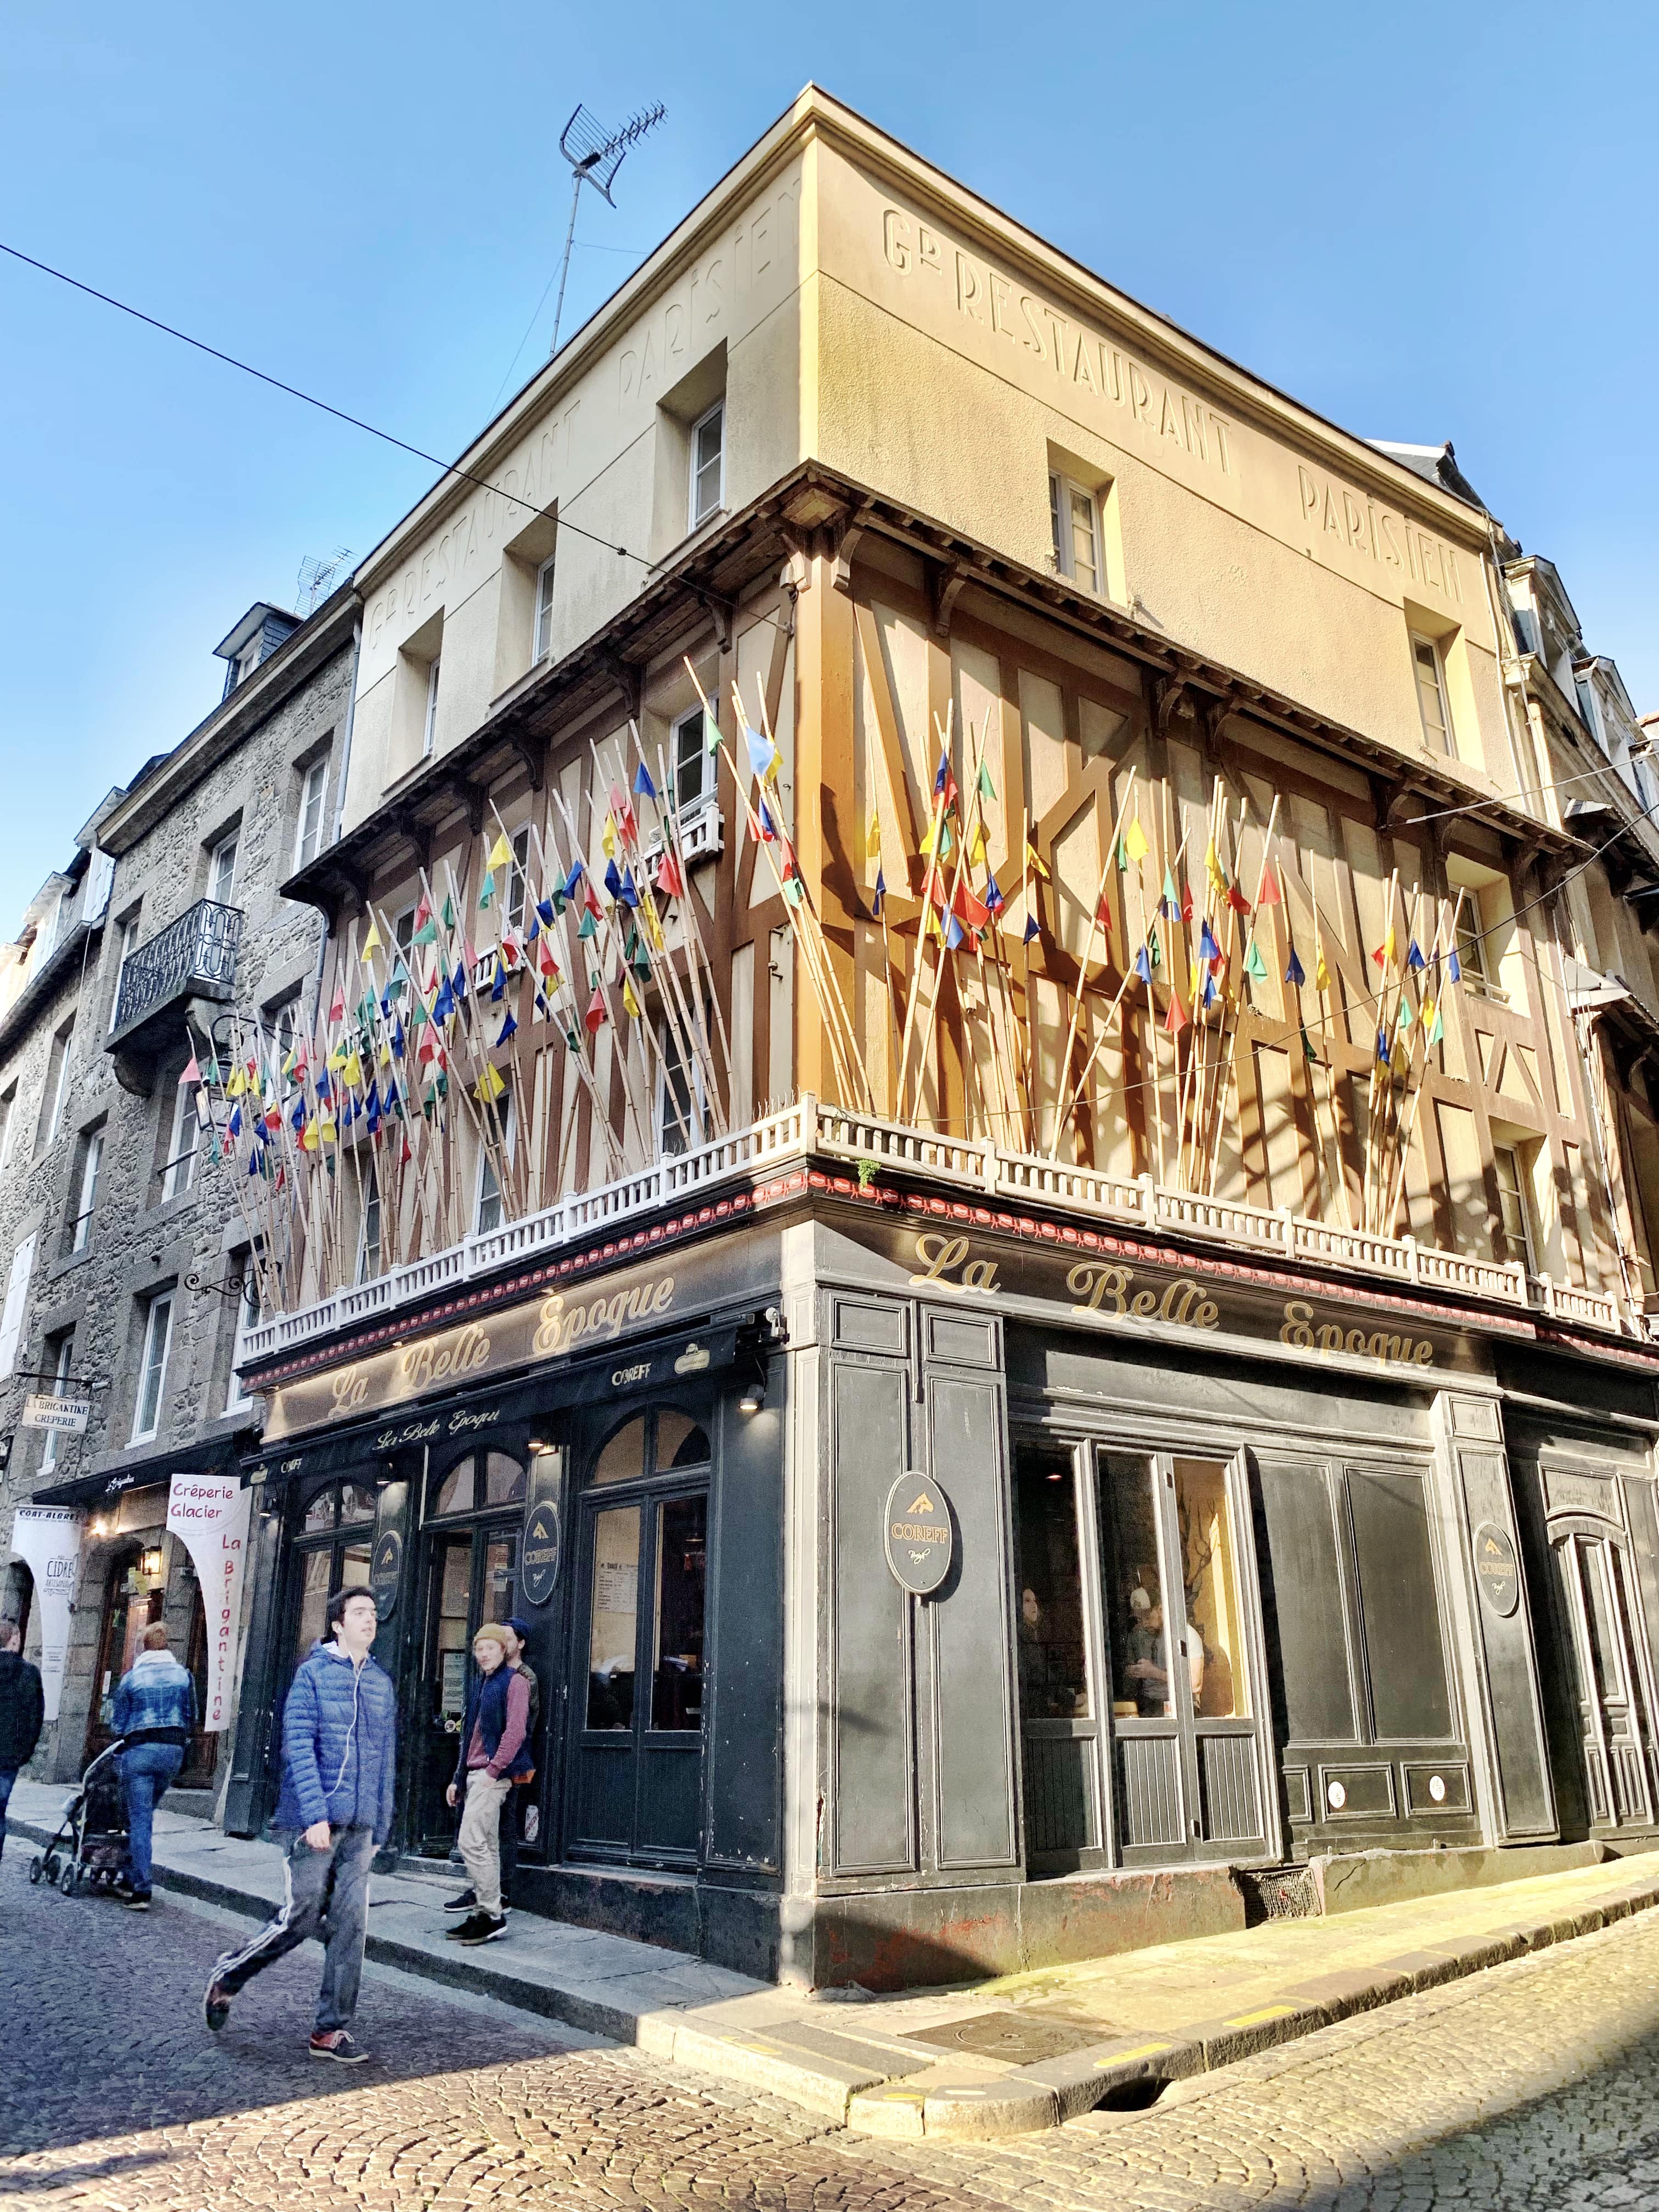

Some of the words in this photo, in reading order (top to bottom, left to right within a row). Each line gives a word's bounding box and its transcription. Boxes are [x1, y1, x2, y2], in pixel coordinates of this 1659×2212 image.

[955, 250, 1232, 476] RESTAURANT
[1297, 464, 1464, 605] PARISIEN
[402, 399, 580, 627] RESTAURANT
[908, 1233, 1001, 1295] La
[1066, 1261, 1220, 1330] Belle
[1279, 1300, 1434, 1370] Epoque
[328, 1364, 370, 1418] La
[399, 1323, 492, 1395] Belle
[531, 1276, 676, 1356] Epoque
[611, 1362, 652, 1386] COREFF
[39, 1400, 89, 1415] BRIGANTINE
[35, 1413, 77, 1427] CREPERIE
[372, 1430, 398, 1451] La
[398, 1419, 440, 1443] Belle
[172, 1482, 234, 1500] Crêperie
[170, 1503, 223, 1519] Glacier
[222, 1534, 241, 1550] La
[890, 1522, 949, 1544] COREFF
[524, 1547, 558, 1566] COREFF
[47, 1561, 74, 1578] CIDRE
